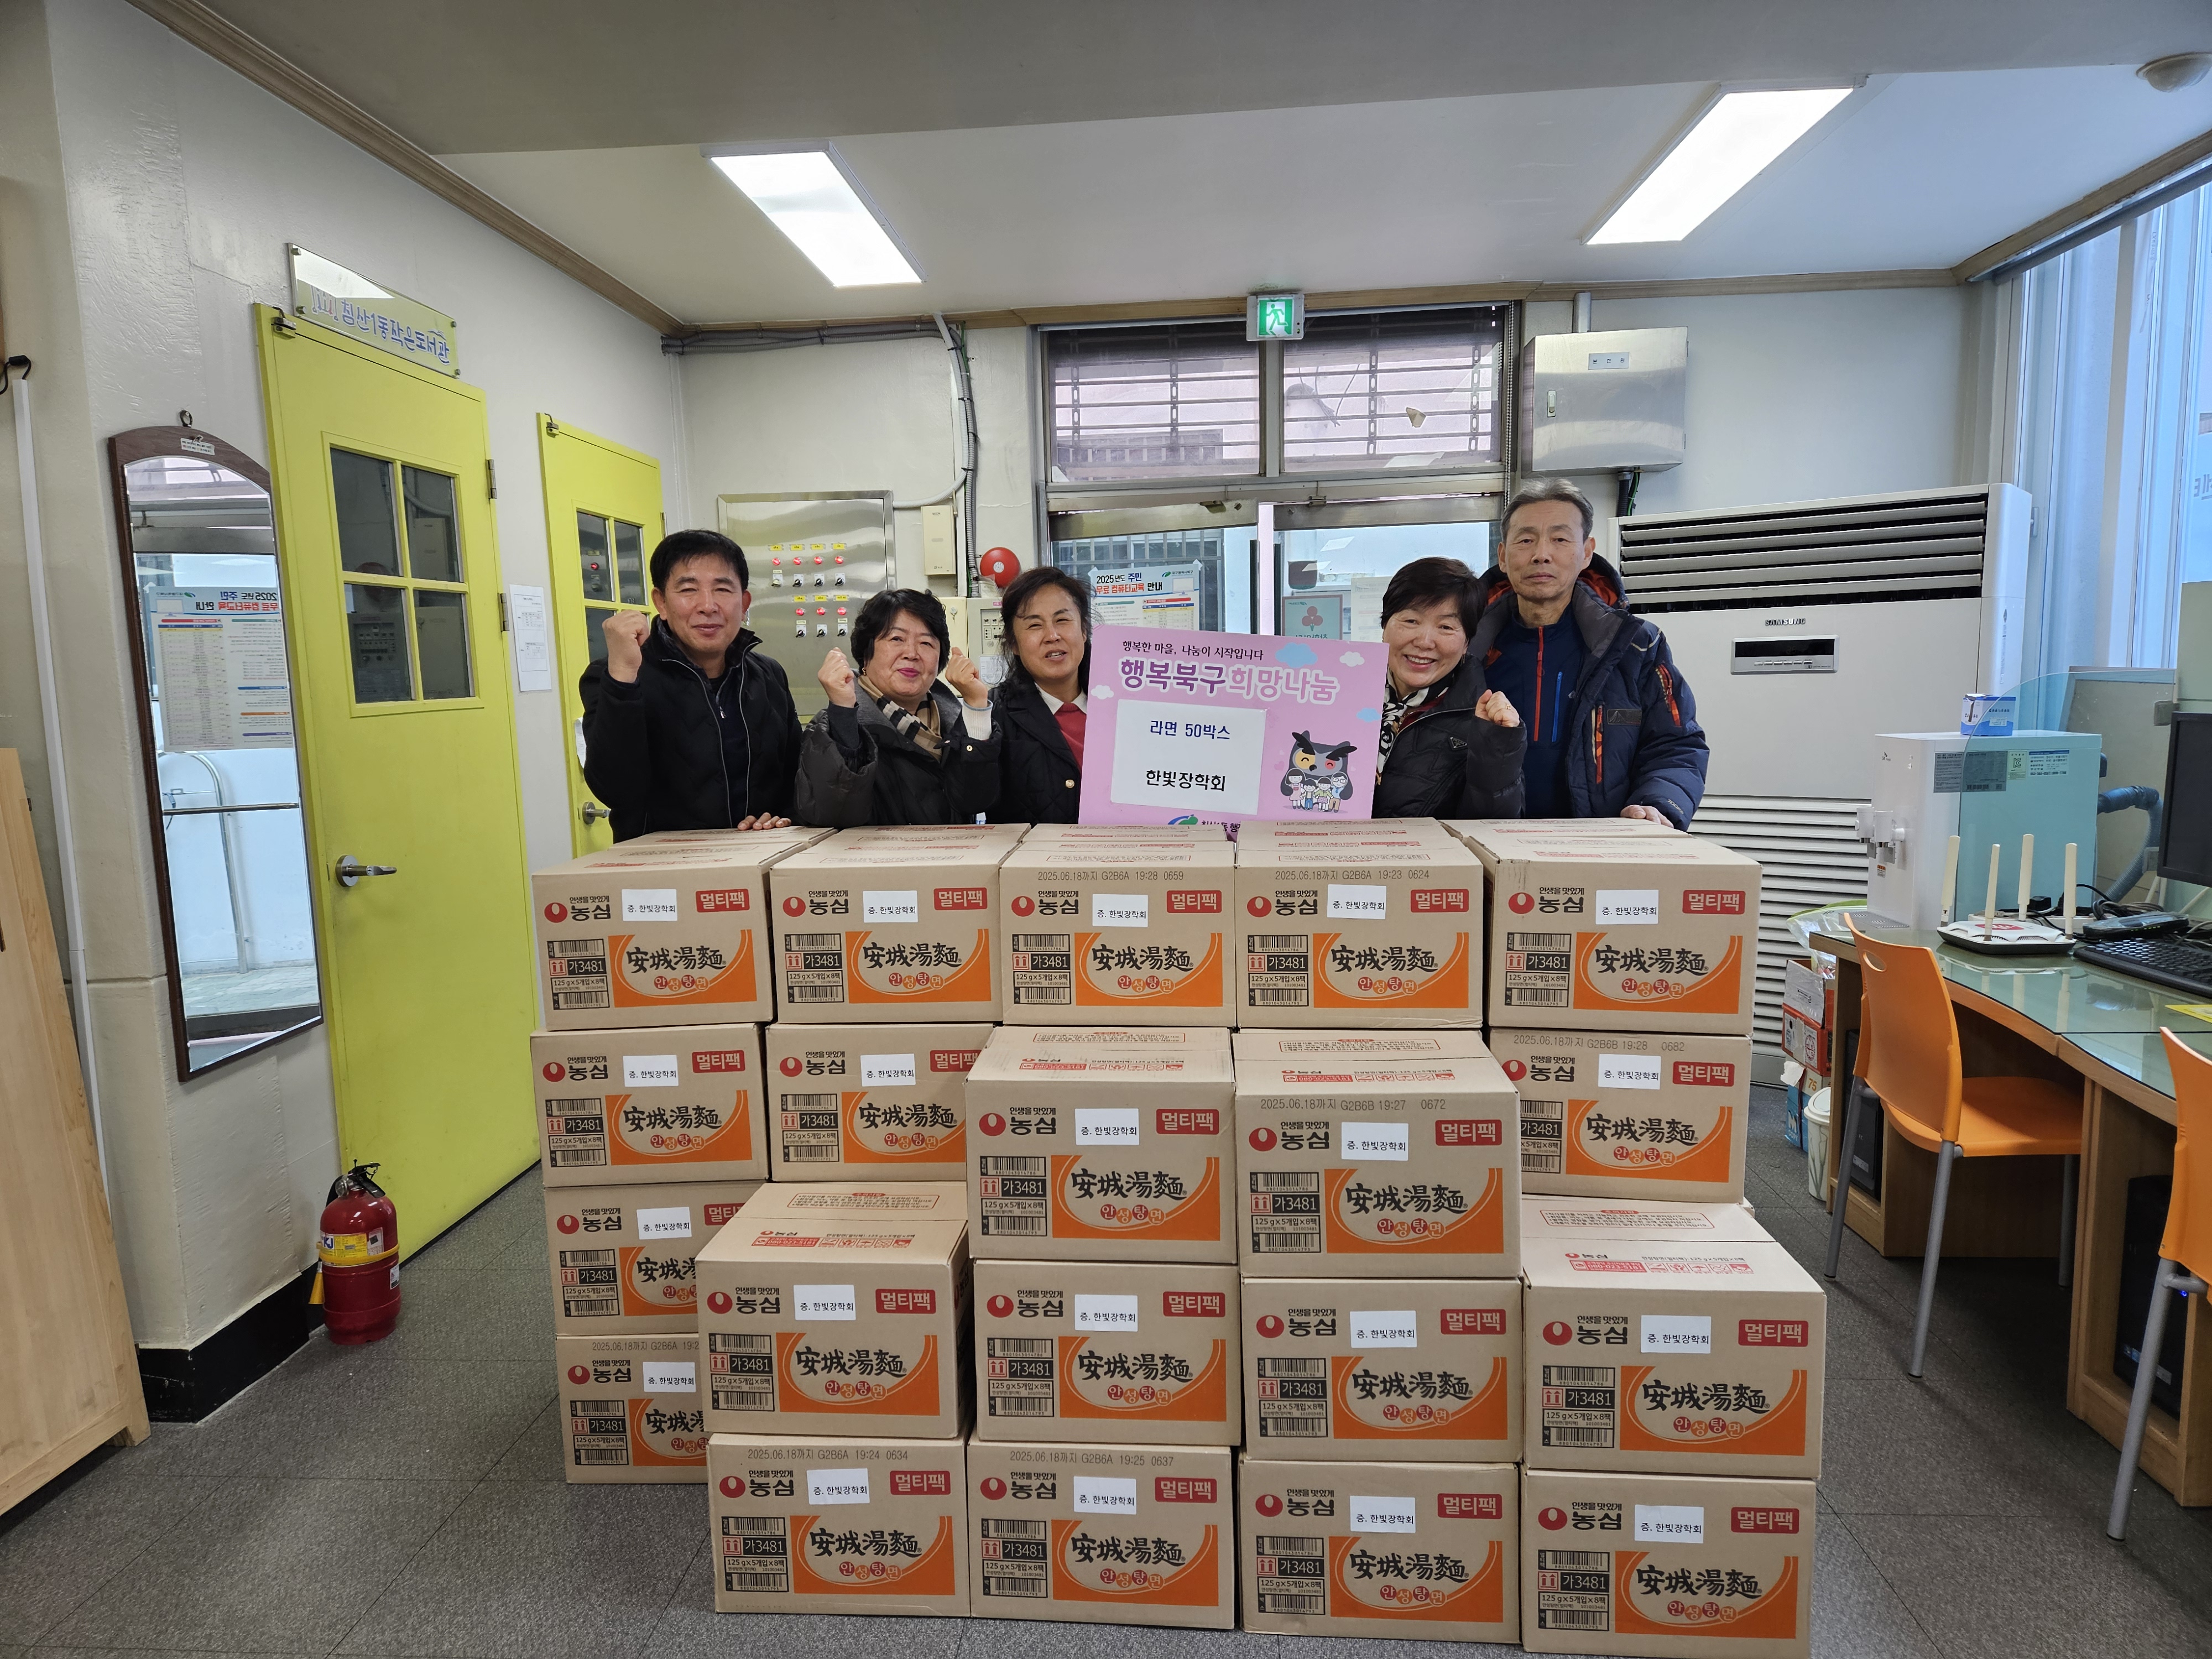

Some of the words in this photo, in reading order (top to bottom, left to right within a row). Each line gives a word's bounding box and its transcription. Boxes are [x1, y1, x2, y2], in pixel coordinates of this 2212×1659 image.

[1128, 572, 1142, 582] 주민
[1096, 585, 1110, 594] 무료
[1111, 583, 1145, 594] 컴퓨터교육
[1147, 581, 1162, 591] 안내
[1765, 618, 1806, 626] SAMSUNG
[1123, 639, 1152, 653] 행복한
[1155, 641, 1177, 655] 마을,
[1182, 644, 1211, 658] 나눔이
[1214, 646, 1264, 661] 시작입니다
[1150, 720, 1177, 737] 라면
[1185, 722, 1231, 740] 50박스
[1146, 769, 1226, 792] 한빛장학회
[1037, 870, 1098, 881] 2025.06.18까지
[1101, 871, 1129, 880] G2B6A
[1135, 871, 1158, 880] 19:28
[1164, 870, 1184, 880] 0659
[1275, 870, 1338, 880] 2025.06.18까지
[1342, 870, 1372, 879] G2B6A
[1378, 870, 1402, 879] 19:23
[1408, 869, 1430, 879] 0624
[939, 890, 982, 907] 멀티팩
[1172, 893, 1217, 910] 멀티팩
[1345, 901, 1384, 910] 한빛장학회
[1416, 892, 1463, 909] 멀티팩
[1538, 896, 1584, 914] 농심
[1688, 893, 1740, 911] 멀티팩
[570, 904, 611, 921] 농심
[1039, 899, 1078, 916] 농심
[1109, 910, 1146, 919] 한빛장학회
[1275, 899, 1318, 916] 농심
[1616, 907, 1656, 915] 한빛장학회
[569, 960, 604, 973] 가3481
[806, 954, 839, 967] 가3481
[1528, 955, 1568, 969] 가3481
[1514, 1035, 1584, 1047] 2025.06.18까지
[1587, 1039, 1618, 1049] G2B6B
[1622, 1040, 1648, 1050] 19:28
[1661, 1041, 1685, 1051] 0682
[697, 1053, 740, 1070] 멀티팩
[806, 1060, 845, 1076] 농심
[1530, 1064, 1575, 1083] 농심
[1618, 1071, 1658, 1081] 한빛장학회
[1678, 1064, 1729, 1084] 멀티팩
[1808, 1077, 1817, 1092] 75
[1260, 1098, 1337, 1109] 2025.06.18까지
[1340, 1100, 1375, 1111] G2B6B
[1379, 1100, 1406, 1110] 19:27
[1421, 1099, 1446, 1109] 0672
[567, 1119, 601, 1132] 가3481
[802, 1115, 835, 1127] 가3481
[1010, 1117, 1056, 1136] 농심
[1281, 1121, 1303, 1130] 인생을
[1305, 1121, 1329, 1130] 맛있게
[1095, 1127, 1136, 1135] 한빛장학회
[1442, 1123, 1495, 1142] 멀티팩
[1281, 1131, 1329, 1150] 농심
[1361, 1141, 1405, 1151] 한빛장학회
[1004, 1181, 1043, 1195] 가3481
[1275, 1197, 1316, 1211] 가3481
[582, 1215, 622, 1232] 농심
[655, 1223, 689, 1231] 한빛장학회
[581, 1270, 614, 1282] 가3481
[736, 1296, 780, 1315] 농심
[881, 1292, 930, 1311] 멀티팩
[1168, 1296, 1218, 1316] 멀티팩
[1094, 1313, 1135, 1322] 한빛장학회
[1447, 1312, 1500, 1331] 멀티팩
[1288, 1318, 1336, 1337] 농심
[1371, 1329, 1414, 1338] 한빛장학회
[1745, 1322, 1802, 1343] 멀티팩
[1577, 1325, 1628, 1346] 농심
[1663, 1334, 1708, 1344] 한빛장학회
[592, 1342, 647, 1351] 2025.06.18까지
[651, 1342, 677, 1350] G2B6A
[683, 1341, 700, 1350] 19:2
[593, 1368, 631, 1383] 농심
[1011, 1362, 1051, 1376] 가3481
[591, 1420, 623, 1432] 가3481
[748, 1449, 813, 1459] 2025.06.18까지
[818, 1449, 849, 1460] G2B6A
[856, 1449, 880, 1459] 19:24
[886, 1450, 908, 1460] 0634
[1010, 1451, 1077, 1464] 2025.06.18까지
[1081, 1453, 1113, 1464] G2B6A
[1120, 1455, 1145, 1465] 19:25
[1151, 1455, 1174, 1467] 0637
[750, 1479, 794, 1497] 농심
[895, 1473, 945, 1492] 멀티팩
[827, 1486, 867, 1495] 한빛장학회
[1011, 1481, 1056, 1501] 농심
[1093, 1496, 1134, 1506] 한빛장학회
[1443, 1496, 1496, 1516] 멀티팩
[1572, 1501, 1596, 1510] 인생을
[1597, 1503, 1622, 1511] 맛있게
[1370, 1515, 1413, 1524] 한빛장학회
[1572, 1511, 1622, 1531] 농심
[1737, 1510, 1793, 1531] 멀티팩
[1656, 1524, 1701, 1533] 한빛장학회
[1005, 1543, 1044, 1558] 가3481
[1281, 1560, 1321, 1575] 가3481
